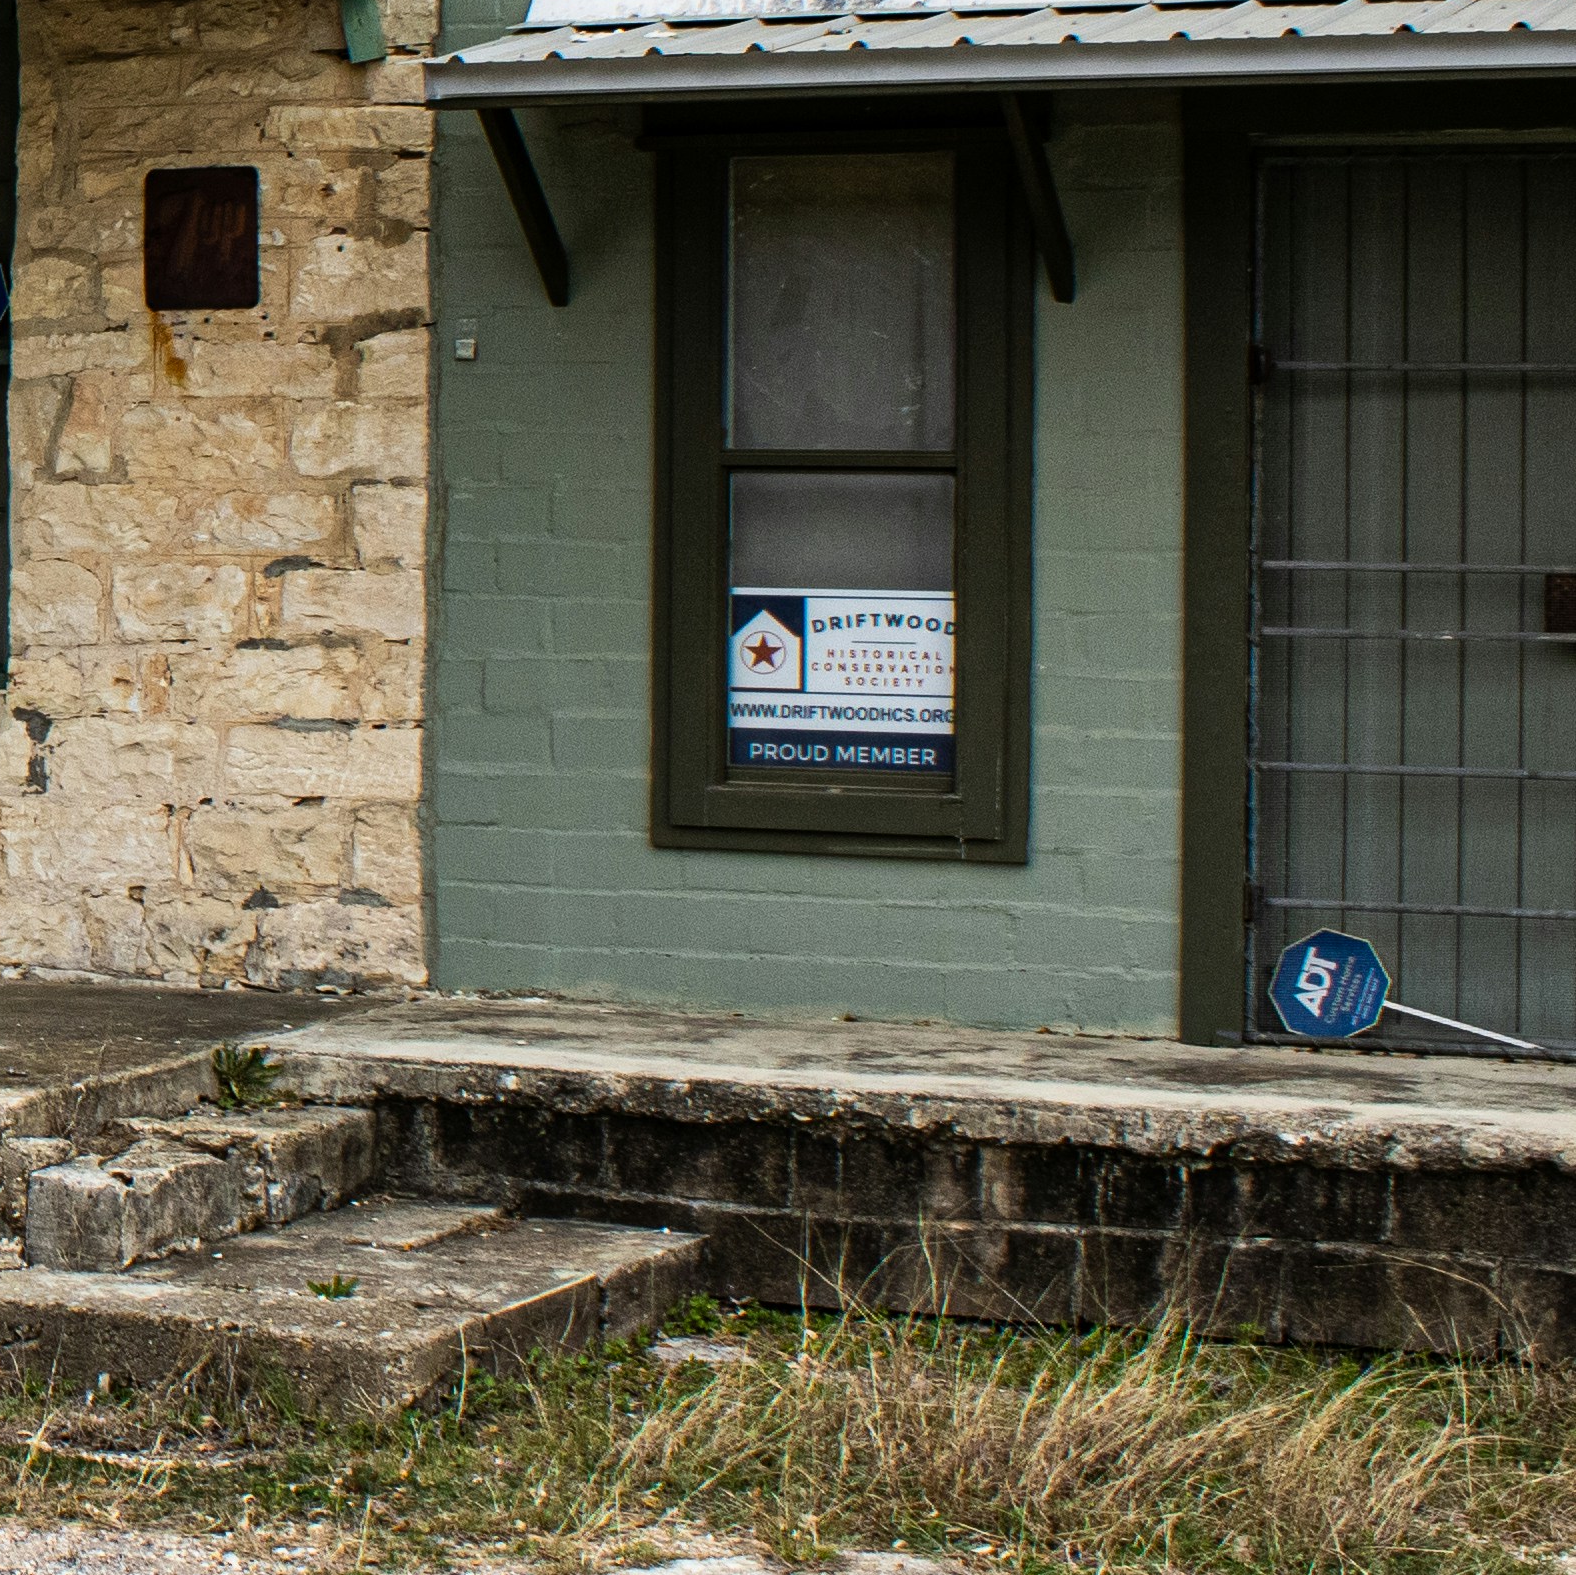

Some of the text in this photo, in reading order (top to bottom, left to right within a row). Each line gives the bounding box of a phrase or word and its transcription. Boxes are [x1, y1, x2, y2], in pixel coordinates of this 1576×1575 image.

[811, 613, 955, 636] DRIFTWOOD
[828, 649, 941, 660] HISTORICAL
[845, 677, 924, 688] SOCIETY
[749, 742, 938, 766] PROUD MEMBER
[1294, 947, 1336, 1017] ADT
